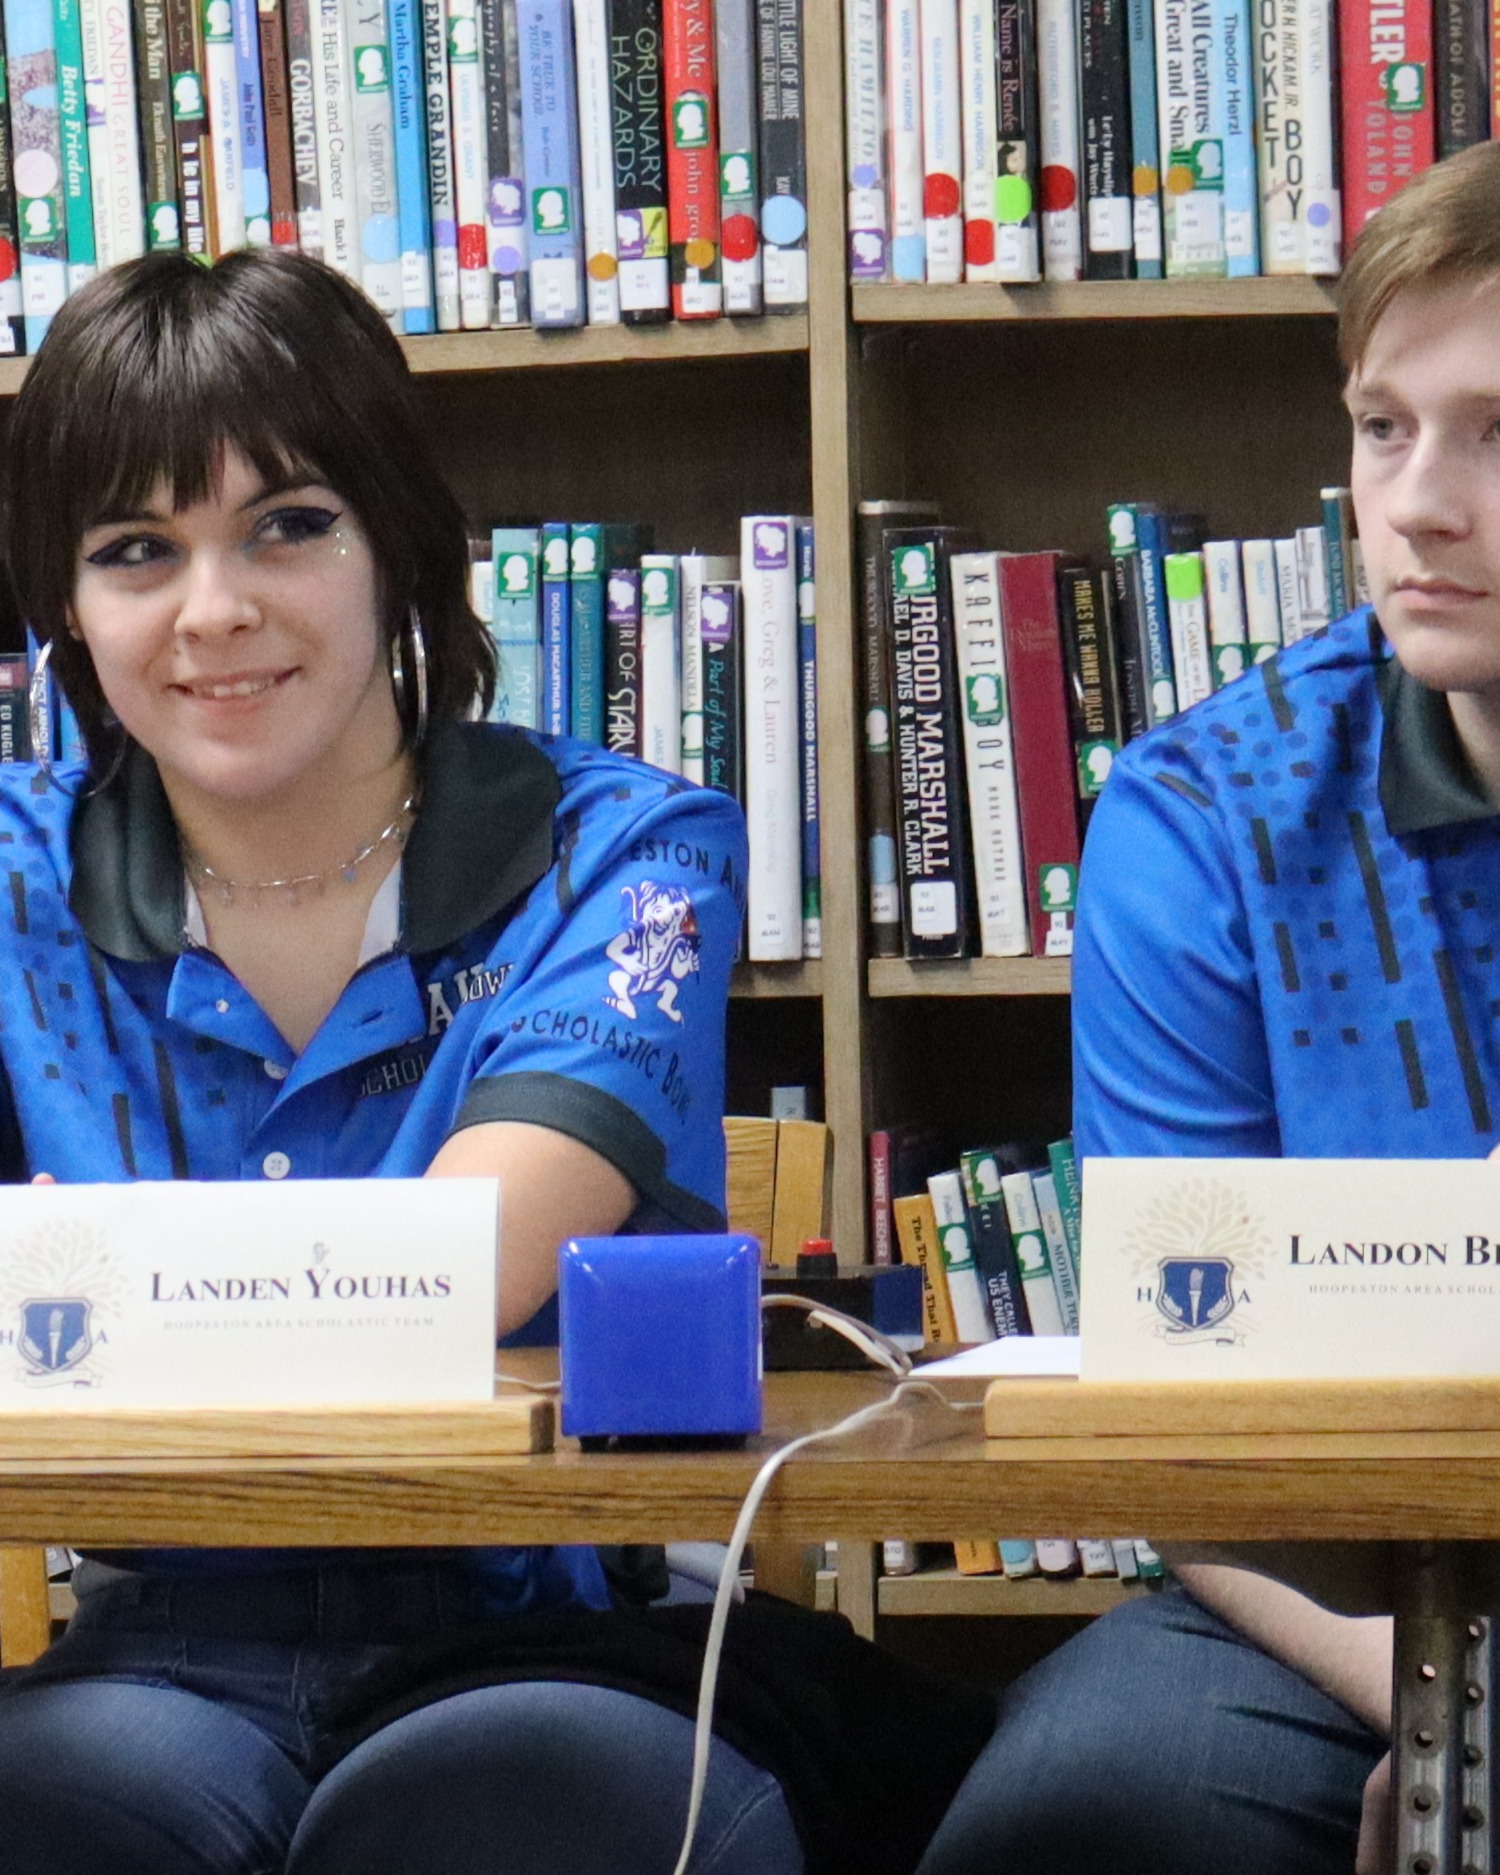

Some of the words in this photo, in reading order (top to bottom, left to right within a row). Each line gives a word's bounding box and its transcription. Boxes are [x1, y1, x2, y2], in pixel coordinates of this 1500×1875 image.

[144, 8, 160, 35] the
[1000, 3, 1018, 56] Name
[1165, 0, 1187, 51] Great
[1190, 0, 1211, 28] All
[107, 6, 129, 106] GANDHI
[147, 38, 162, 79] Man
[322, 32, 338, 61] His
[687, 43, 706, 78] Me
[779, 31, 799, 64] LIGHT
[1002, 60, 1015, 73] is
[1223, 14, 1240, 84] Theodor
[62, 66, 80, 115] Betty
[323, 64, 339, 96] Life
[397, 65, 412, 129] Graham
[780, 67, 799, 84] OF
[1167, 59, 1189, 97] and
[1193, 32, 1212, 134] Creatures
[290, 59, 317, 186] GORBACHEV
[327, 100, 342, 135] and
[610, 35, 637, 189] HAZARDS
[634, 27, 661, 192] ORDINARY
[781, 88, 800, 120] MINE
[1226, 90, 1242, 136] Herzl
[65, 118, 84, 198] Friedan
[329, 138, 345, 200] Career
[428, 93, 447, 207] GRANDIN
[1284, 119, 1304, 221] BOY
[684, 150, 701, 195] john
[117, 185, 131, 236] SOUL
[1140, 550, 1154, 603] BARBARA
[1279, 565, 1292, 609] MARIA
[551, 592, 560, 642] DOUGLAS
[685, 586, 697, 638] NELSON
[1073, 580, 1093, 620] MAKES
[757, 621, 779, 668] Greg
[1077, 624, 1095, 641] ME
[1185, 621, 1200, 661] GAME
[619, 652, 636, 681] OF
[707, 658, 724, 694] Part
[897, 647, 915, 701] DAVIS
[1081, 645, 1098, 684] WANNA
[0, 705, 12, 721] ED
[804, 660, 816, 742] THURGOOD
[899, 705, 914, 718] &
[1084, 689, 1104, 732] HOLLER
[705, 722, 726, 749] My
[762, 699, 780, 765] Lauren
[710, 755, 727, 788] Soul
[899, 723, 919, 795] HUNTER
[805, 745, 817, 822] MARSHALL
[915, 711, 949, 875] MARSHALL
[903, 799, 919, 814] R.
[905, 819, 922, 875] CLARK
[873, 1157, 886, 1203] HARRIET
[875, 1209, 889, 1258] BEECHER
[1288, 1234, 1449, 1267] LANDON
[148, 1271, 291, 1302] LANDEN
[303, 1267, 452, 1300] YOUHAS
[911, 1216, 923, 1252] The
[922, 1293, 938, 1328] That
[987, 1278, 1000, 1296] US
[997, 1270, 1009, 1299] THEY
[1052, 1243, 1074, 1298] MOTHER
[1308, 1283, 1400, 1296] HOOPESTON
[1403, 1283, 1444, 1295] AREA
[1136, 1288, 1152, 1303] H
[1237, 1288, 1252, 1304] A
[94, 1328, 109, 1345] A
